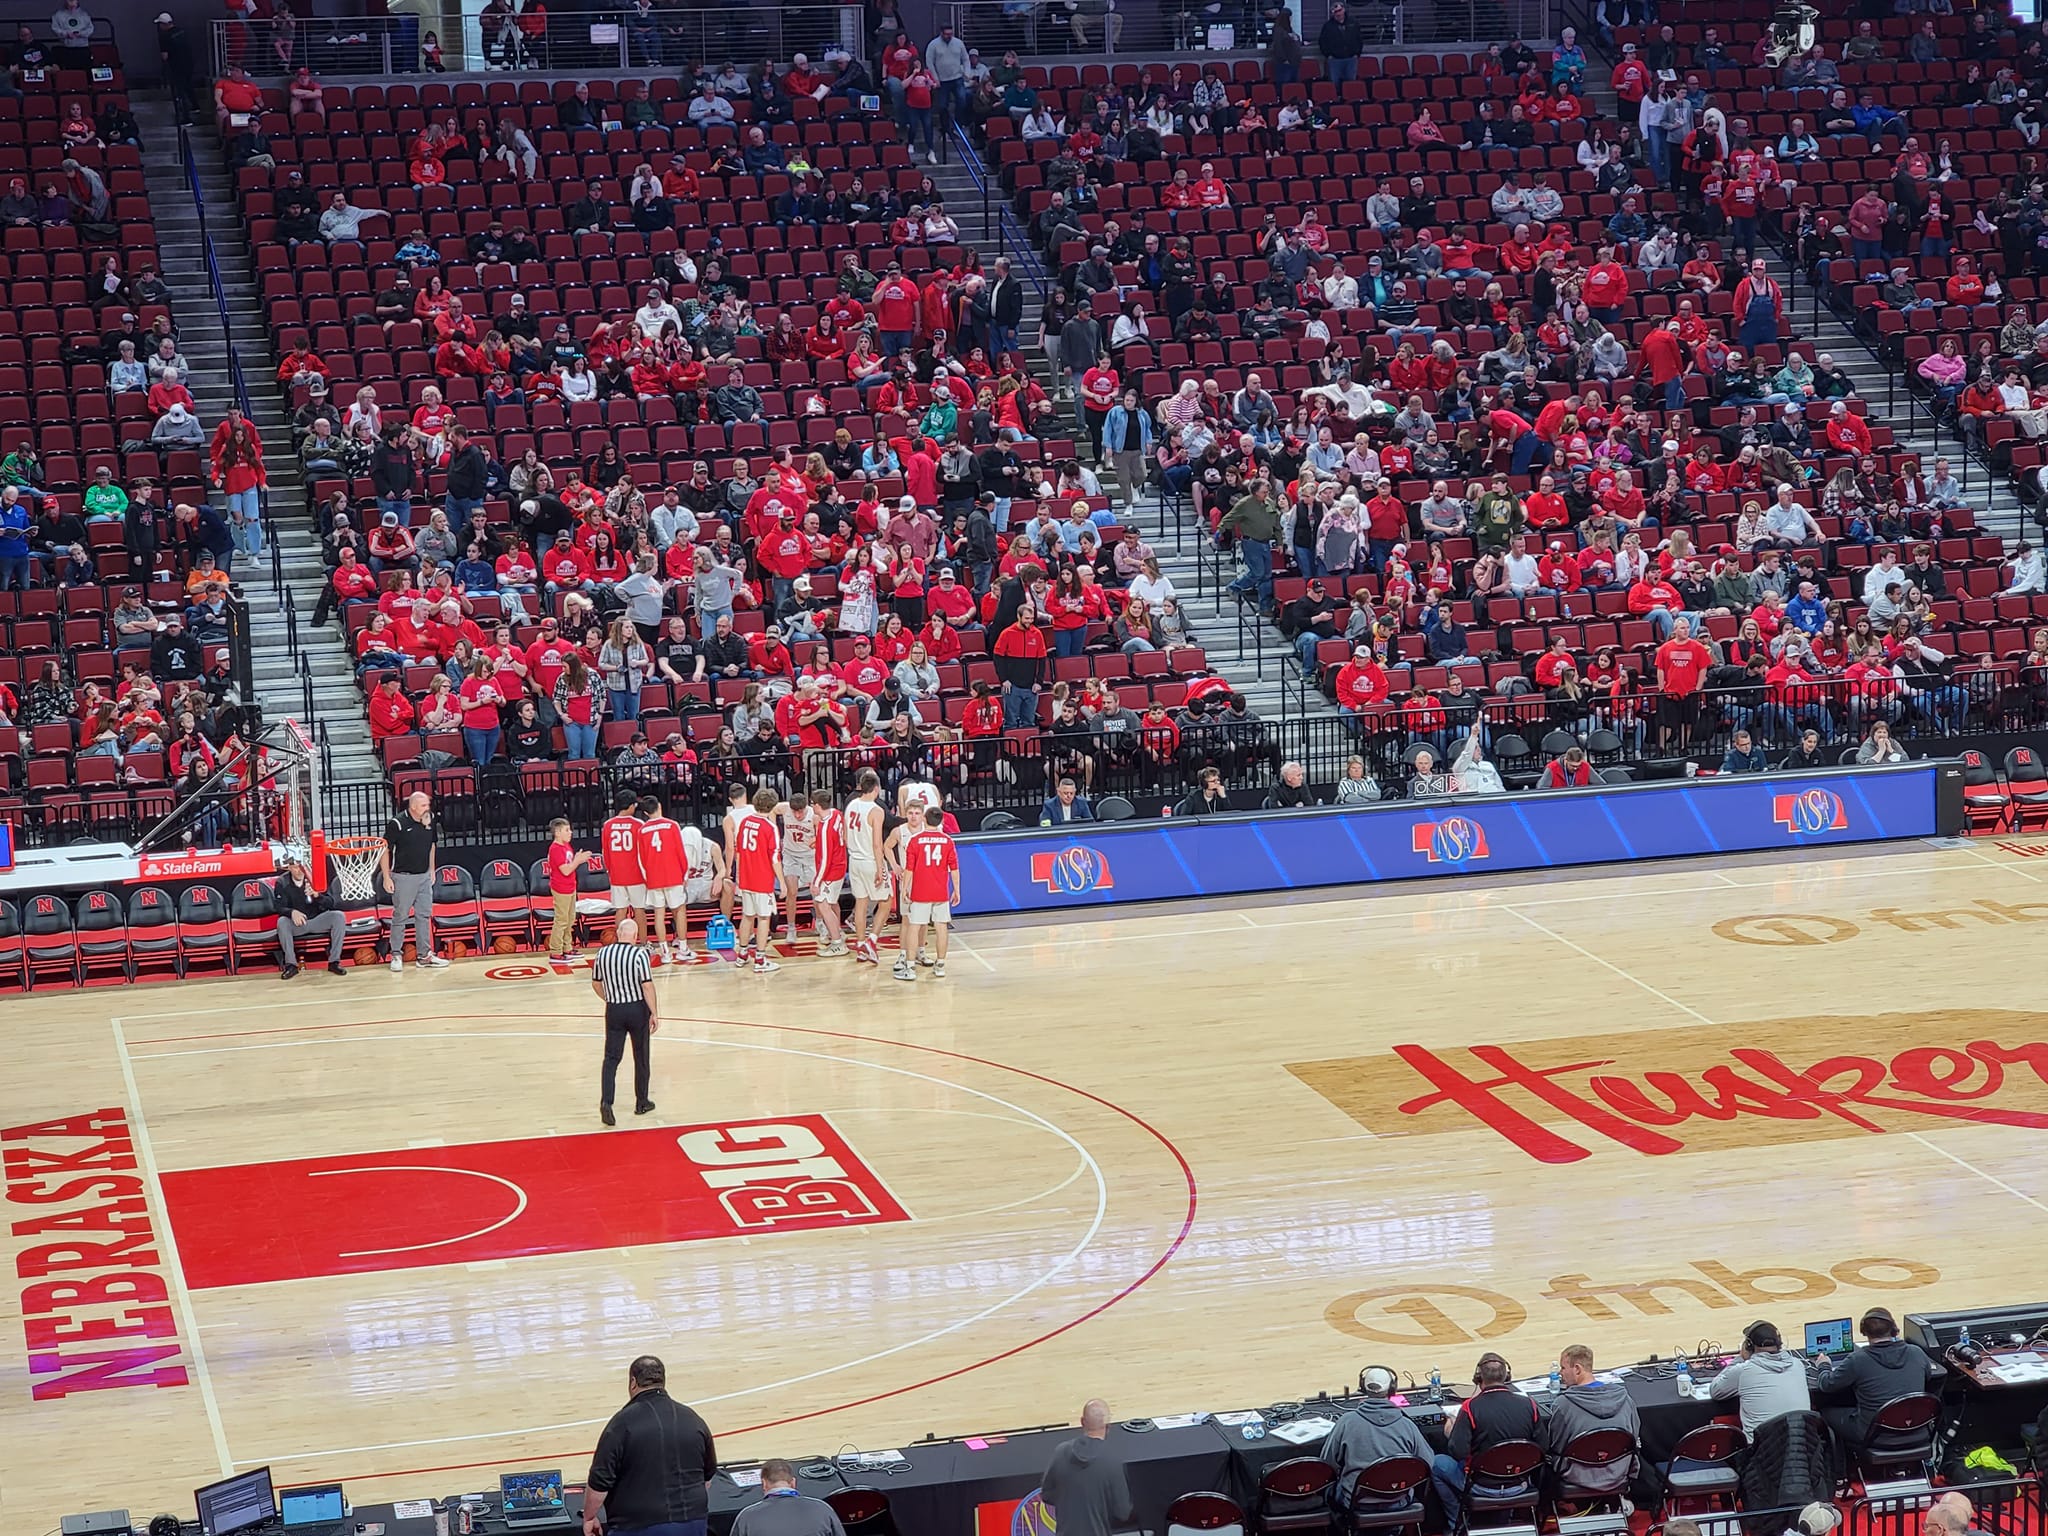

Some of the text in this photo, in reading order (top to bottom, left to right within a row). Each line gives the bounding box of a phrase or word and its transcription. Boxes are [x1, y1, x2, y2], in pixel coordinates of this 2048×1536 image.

[1966, 752, 1981, 767] N
[2016, 750, 2031, 764] N
[849, 811, 861, 832] 24
[610, 830, 634, 852] 20
[651, 831, 663, 852] 4
[742, 828, 759, 851] 15
[923, 844, 943, 867] 14
[493, 861, 511, 877] N
[587, 856, 603, 872] N
[442, 867, 459, 883] N
[141, 890, 158, 906] N
[191, 887, 208, 903] N
[243, 882, 261, 898] N
[37, 898, 54, 913] N
[90, 894, 107, 909] N
[1, 1107, 189, 1401] NEBRASKA
[1541, 1259, 1941, 1320] fnbo
